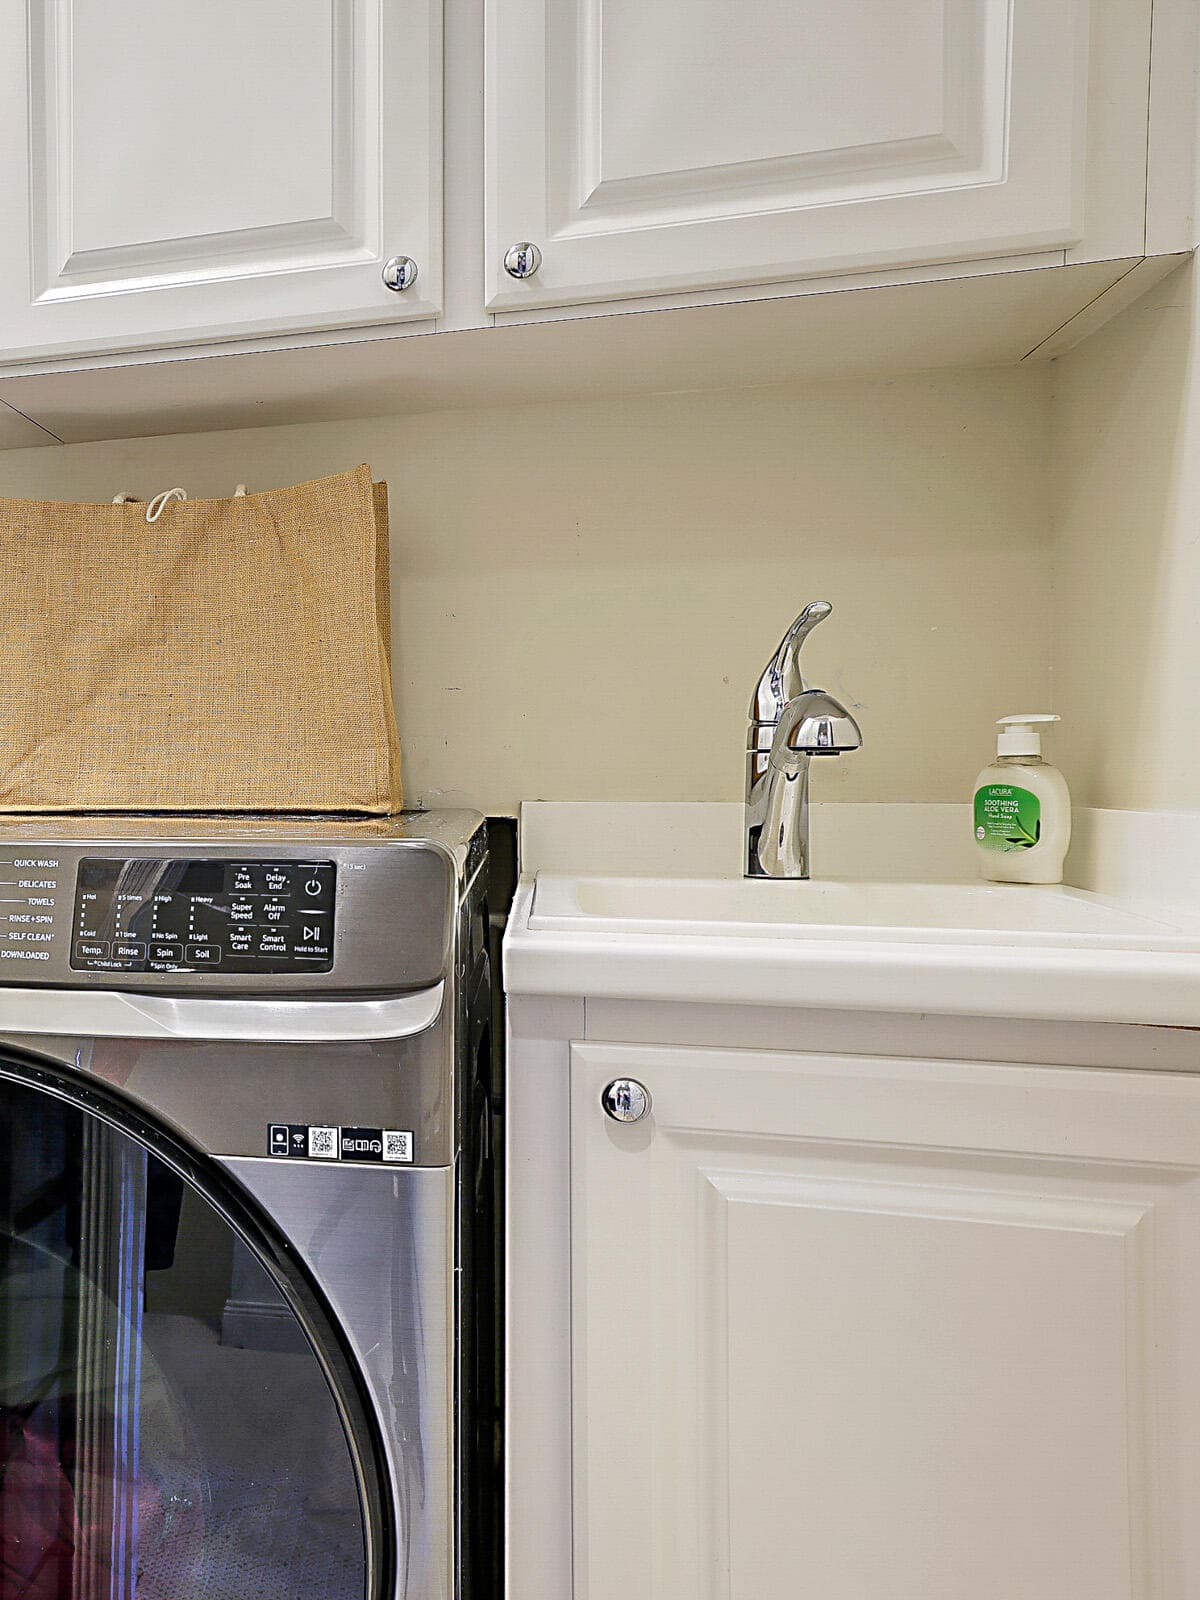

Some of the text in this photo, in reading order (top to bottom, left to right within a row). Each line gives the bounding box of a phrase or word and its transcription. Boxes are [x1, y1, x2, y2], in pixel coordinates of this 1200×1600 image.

[14, 859, 59, 868] QUICK WASH
[237, 873, 250, 881] Pre
[265, 873, 286, 882] Delay
[18, 880, 57, 888] DELICATES
[234, 881, 252, 889] Soak
[268, 881, 283, 890] End
[27, 897, 55, 906] TOWELS
[195, 896, 213, 904] Heavy
[231, 903, 252, 912] Super
[263, 903, 286, 912] Alarm
[230, 910, 253, 920] Speed
[267, 911, 281, 920] Off
[8, 932, 27, 941] SELF
[193, 933, 208, 941] Light
[229, 933, 252, 942] Smart
[262, 934, 285, 943] Smart
[81, 946, 103, 955] Temp.
[231, 941, 249, 951] Care
[260, 942, 287, 952] Control
[294, 945, 309, 953] Hold
[314, 946, 329, 954] Start
[0, 950, 49, 960] DOWNLOADED
[118, 947, 139, 956] Rinse
[156, 948, 174, 958] Spin
[195, 950, 210, 959] Soil
[165, 962, 178, 970] Only
